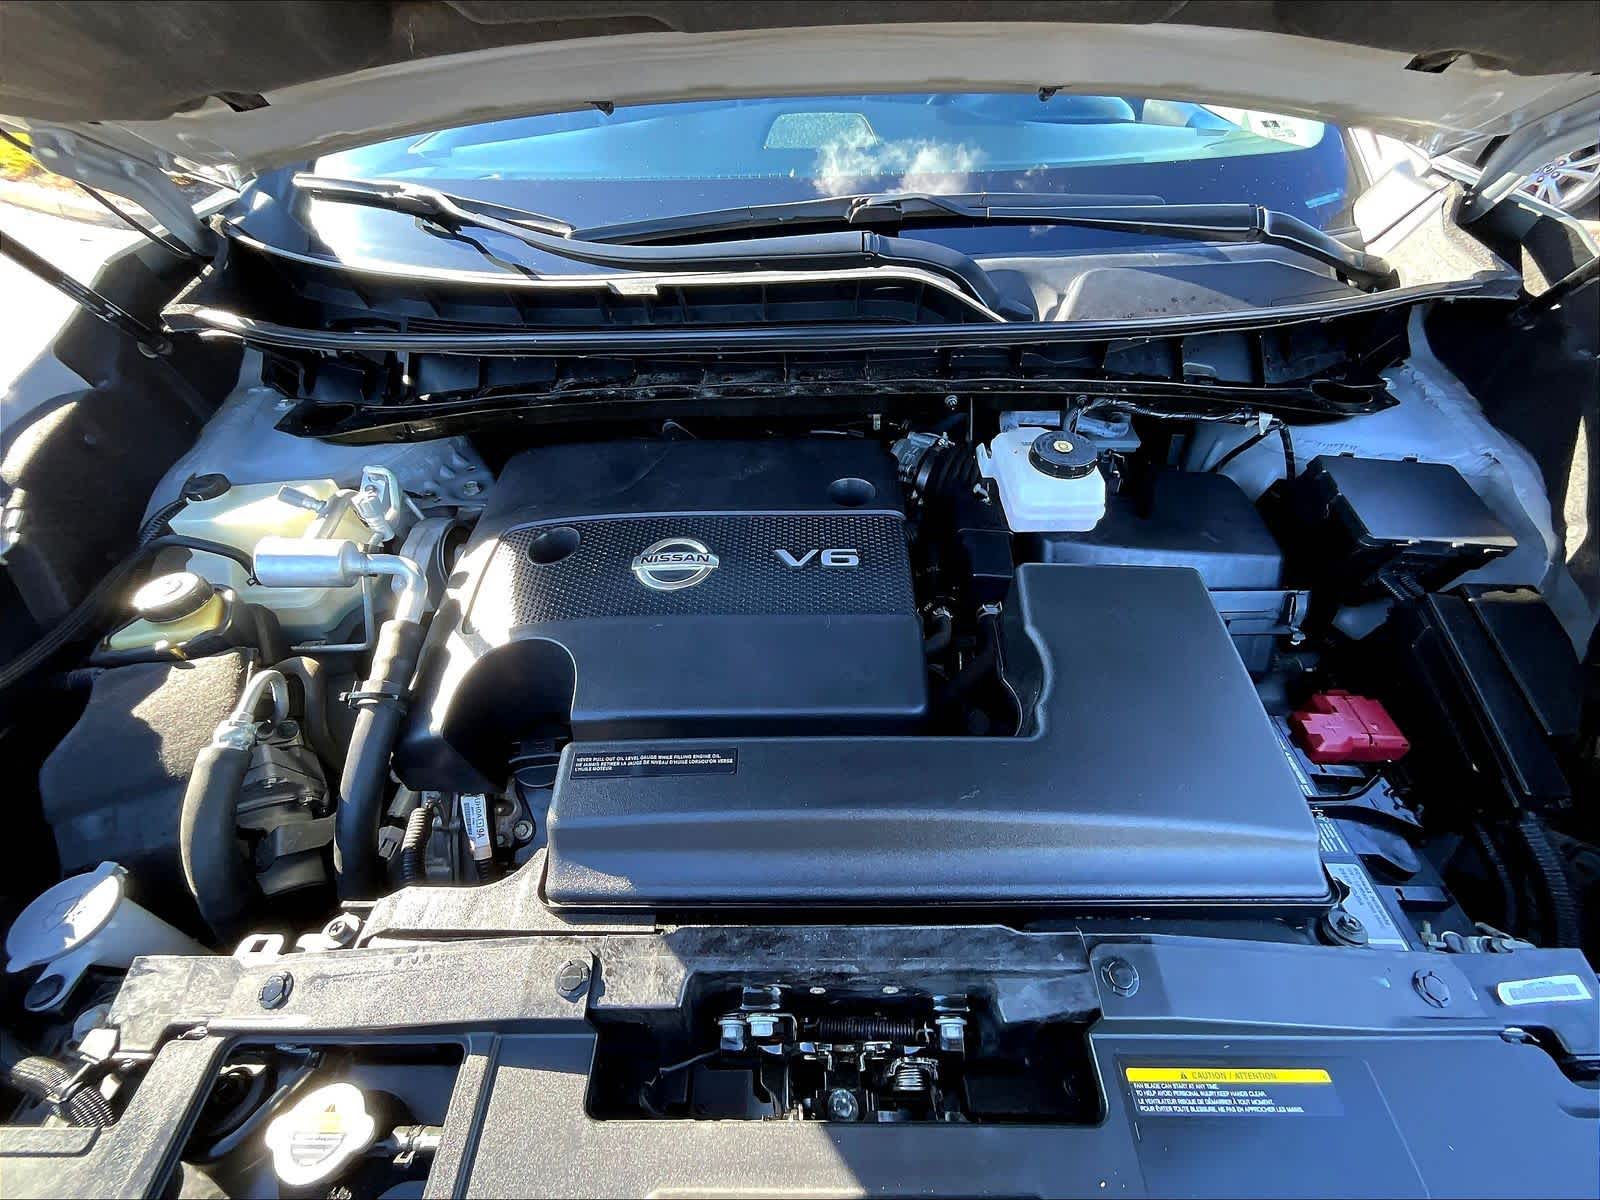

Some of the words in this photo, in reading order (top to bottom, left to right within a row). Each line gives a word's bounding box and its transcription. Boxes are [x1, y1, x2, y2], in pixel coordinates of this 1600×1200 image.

[640, 553, 710, 565] NISSAN
[775, 548, 860, 569] V6
[1192, 1072, 1227, 1080] CAUTION
[1235, 1072, 1277, 1080] ATTENTION
